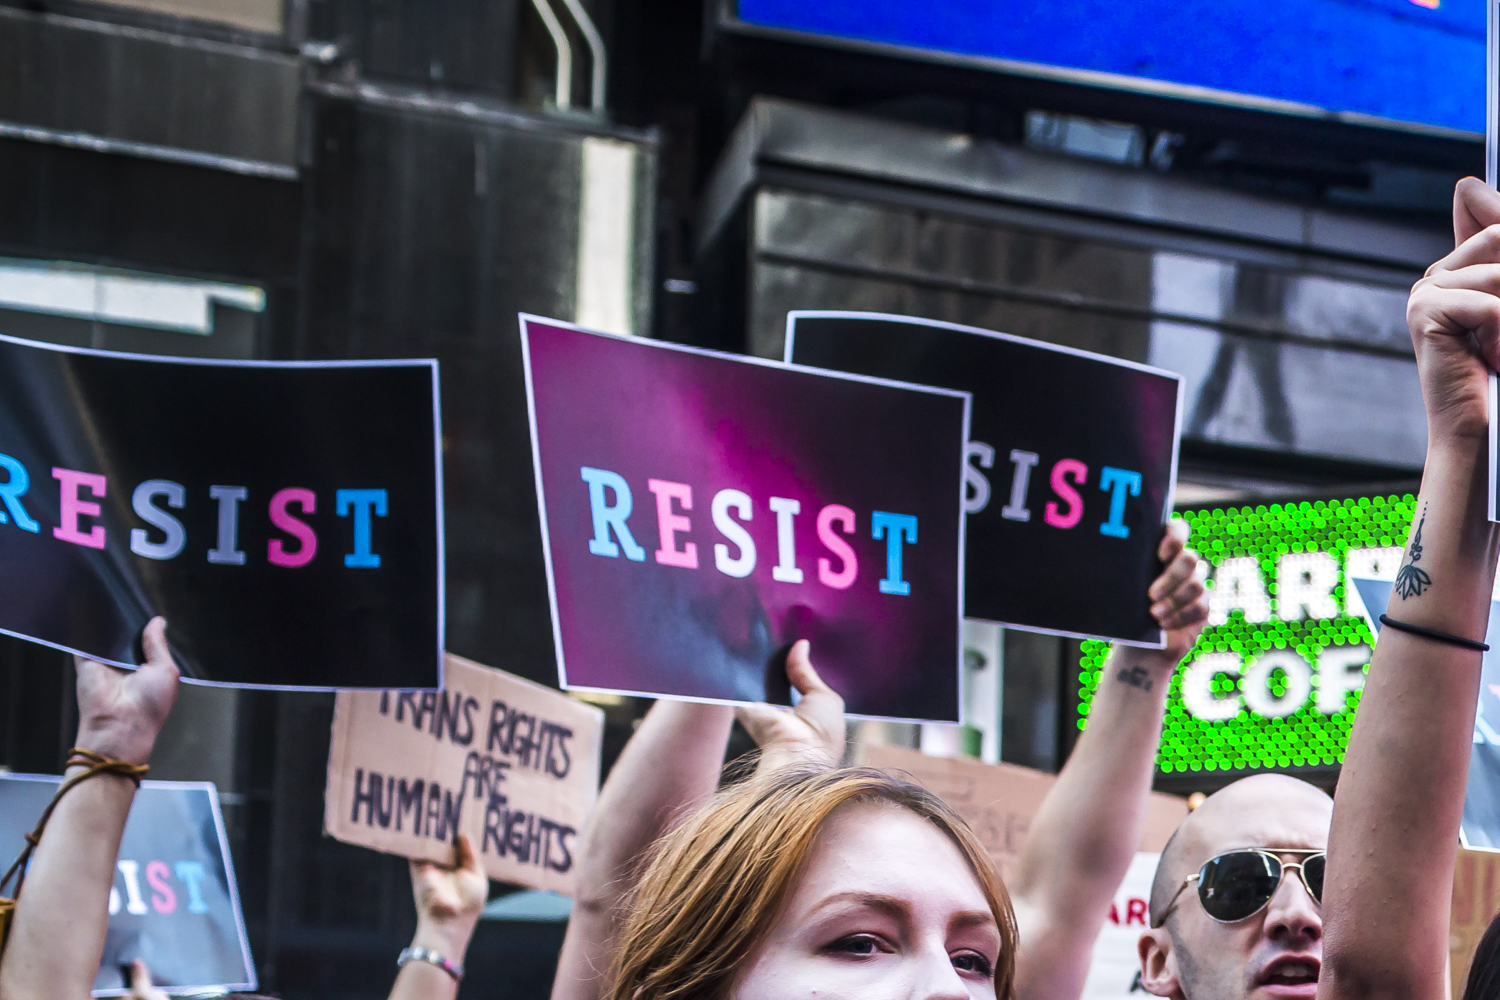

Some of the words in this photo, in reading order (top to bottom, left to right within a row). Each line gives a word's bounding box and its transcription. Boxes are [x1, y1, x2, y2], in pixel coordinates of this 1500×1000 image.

[580, 466, 918, 595] RESIST
[462, 752, 511, 803] ARE
[486, 700, 573, 779] RIGHTS
[351, 769, 463, 846] HUMAN
[482, 805, 577, 873] RIGHTS
